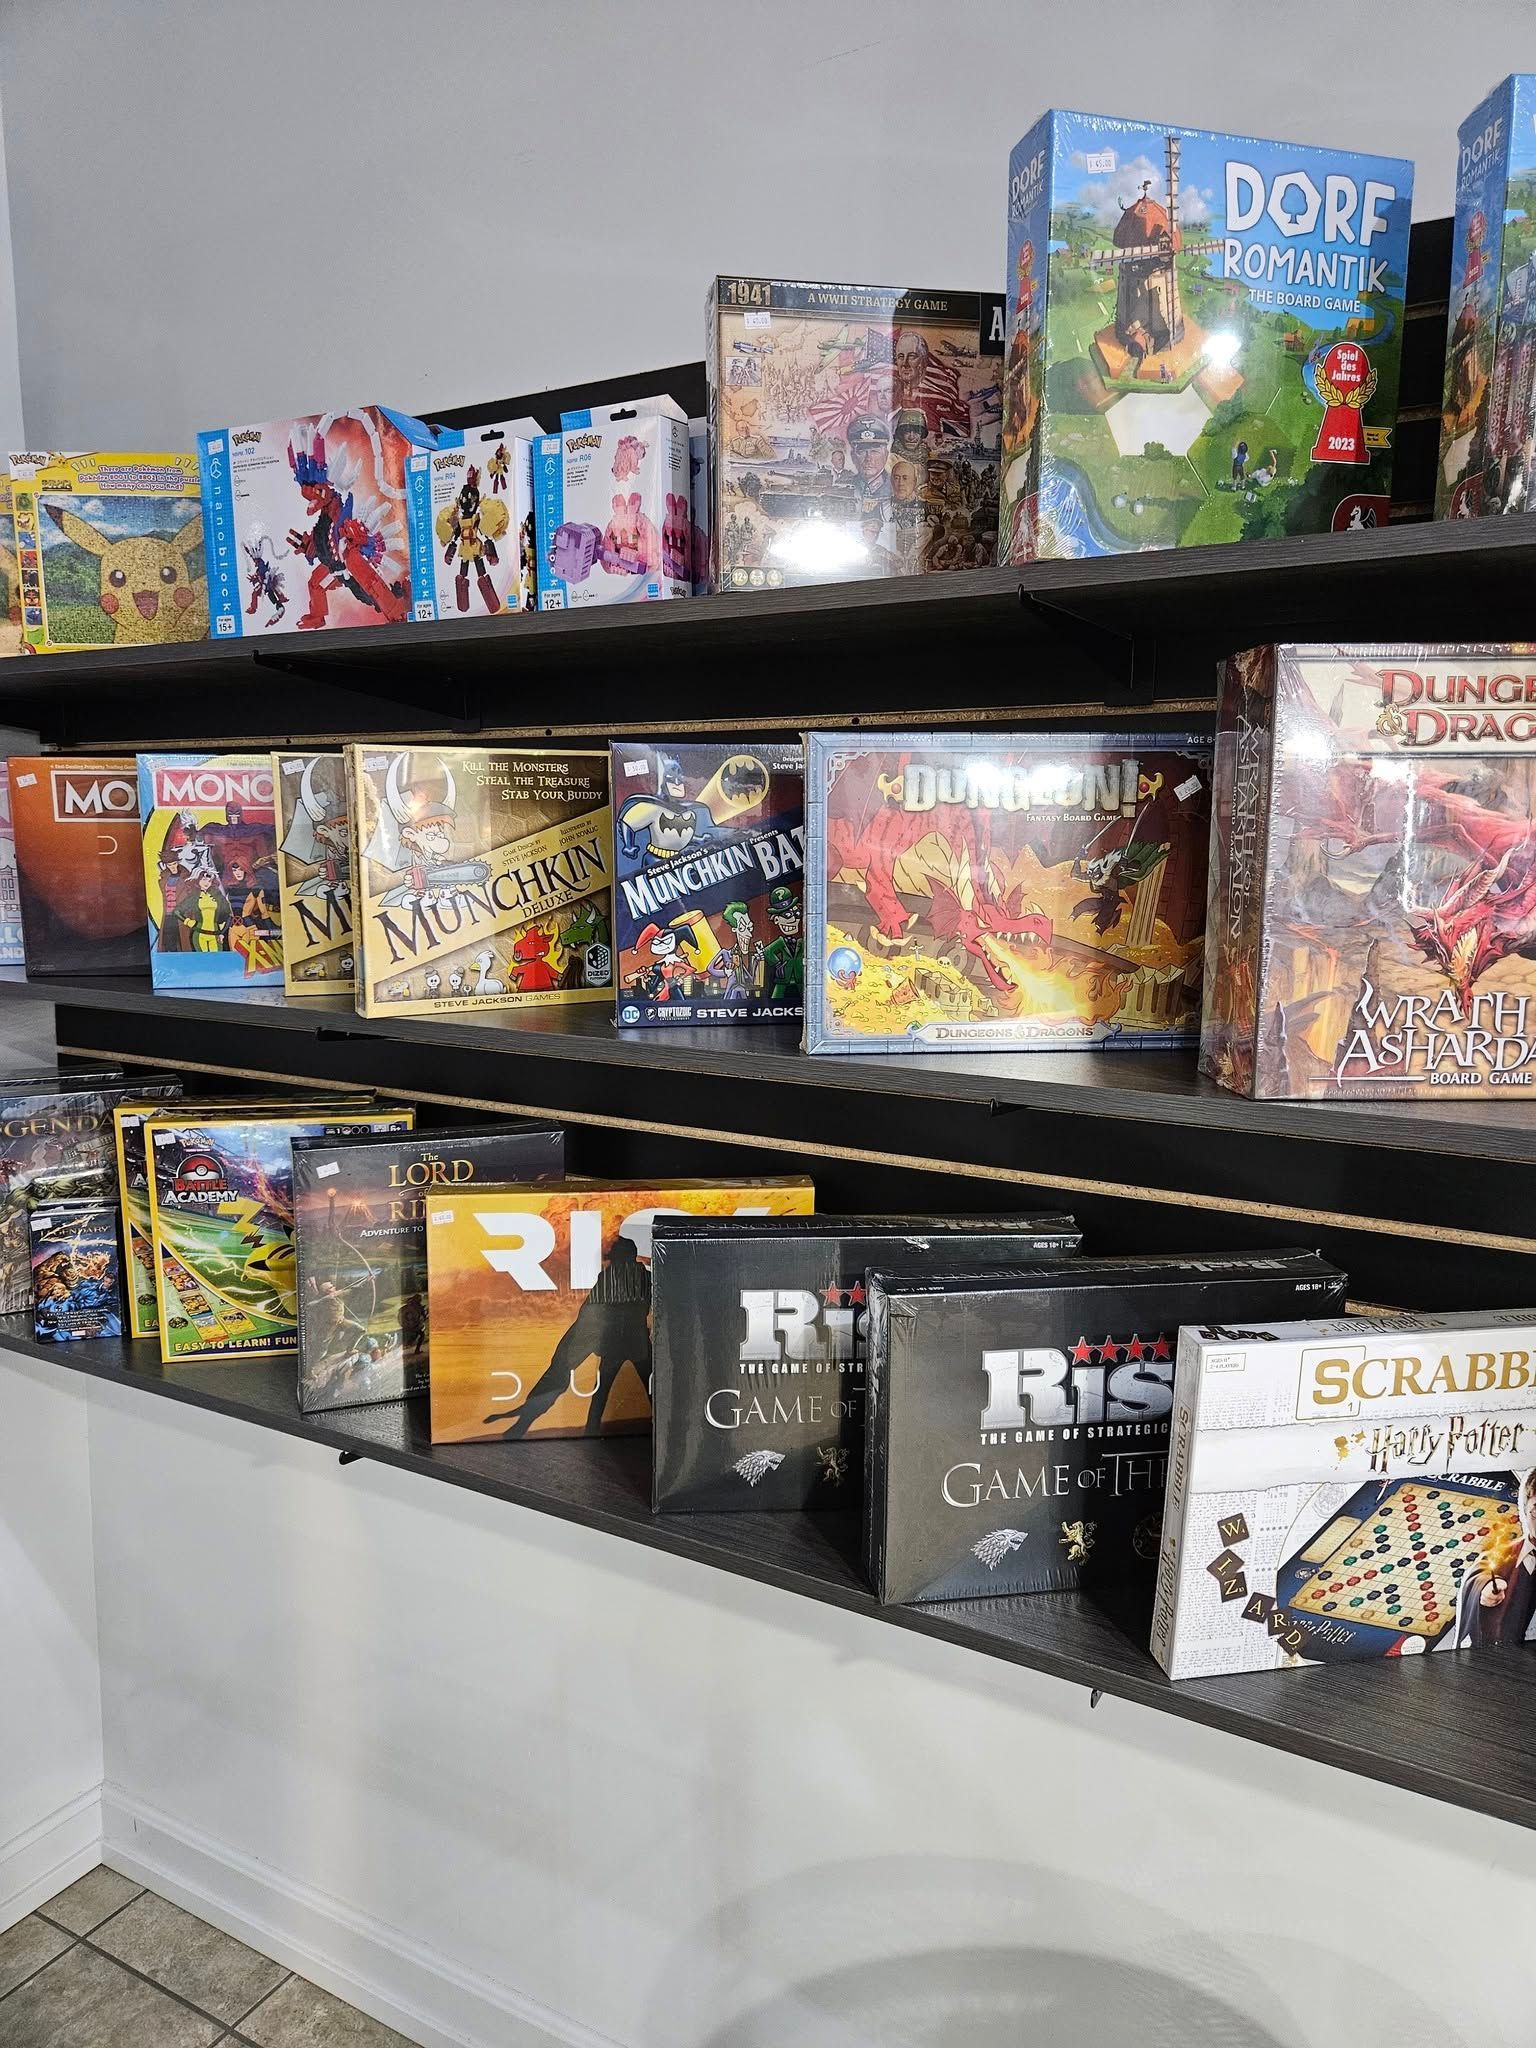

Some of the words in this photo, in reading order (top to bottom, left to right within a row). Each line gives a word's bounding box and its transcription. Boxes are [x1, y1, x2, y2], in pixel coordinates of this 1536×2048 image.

[1462, 117, 1503, 174] DORF
[1012, 149, 1046, 202] DORF
[1225, 160, 1397, 247] DORF
[1224, 238, 1388, 293] ROMANTIK
[727, 282, 771, 306] 1941
[807, 293, 816, 303] A
[818, 293, 848, 305] WWII
[851, 296, 910, 309] STRATEGY
[914, 299, 948, 311] GAME
[1249, 288, 1274, 304] THE
[1277, 292, 1320, 308] BOARD
[1324, 297, 1360, 313] GAME
[1336, 349, 1359, 363] Spiel
[1340, 360, 1356, 372] des
[1332, 370, 1361, 382] Jahres
[244, 447, 255, 455] 102
[1328, 437, 1355, 450] 2023
[133, 465, 164, 473] Pokémon
[165, 466, 183, 474] from
[547, 481, 558, 586] nanoblock
[214, 486, 231, 611] nanoblock
[417, 498, 429, 598] nanoblock
[734, 573, 746, 582] 12+
[544, 599, 562, 609] 12+
[417, 609, 432, 620] 12+
[219, 622, 232, 632] 15+
[1376, 703, 1409, 738] &
[1400, 708, 1536, 748] DRAG
[1187, 736, 1207, 744] AGE
[462, 760, 484, 774] KILL
[488, 761, 509, 771] THE
[513, 762, 569, 774] MONSTERS
[772, 762, 794, 770] Steve
[162, 774, 273, 802] MONO
[476, 775, 511, 786] STEAL
[514, 776, 534, 786] THE
[538, 776, 590, 788] TREASURE
[903, 758, 1139, 818] DUNGEON!
[64, 780, 137, 814] MO
[501, 789, 530, 800] STAB
[533, 790, 567, 801] YOUR
[567, 791, 603, 801] BUDDY
[1026, 813, 1062, 822] FANTASY
[1063, 813, 1092, 822] BOARD
[1094, 814, 1118, 822] GAME
[559, 836, 576, 847] JOHN
[749, 829, 779, 844] Presents
[503, 856, 520, 866] STEVE
[521, 845, 548, 861] JACKSON
[647, 861, 671, 877] Steve
[670, 848, 709, 870] Jackson's
[621, 841, 754, 921] MUNCHKIN
[373, 836, 607, 965] MUNCHKIN
[522, 889, 573, 918] DELUXE
[587, 969, 609, 977] DIZED
[434, 1000, 468, 1009] STEVE
[472, 996, 522, 1006] JACKSON
[526, 993, 561, 1002] GAMES
[1355, 977, 1530, 1038] WRATH
[624, 1009, 640, 1020] DC
[657, 1006, 692, 1017] CRYPTOZOIC
[697, 1009, 747, 1018] STEVE
[752, 1007, 804, 1017] JACKS
[935, 1027, 1013, 1039] DUNGEONS
[1025, 1026, 1095, 1038] DRAGONS
[1430, 1073, 1482, 1084] BOARD
[1489, 1073, 1532, 1084] GAME
[0, 1116, 114, 1138] GENDA
[420, 1152, 439, 1162] The
[388, 1159, 475, 1188] LORD
[174, 1178, 228, 1191] BATTLE
[161, 1190, 239, 1206] ACADEMY
[360, 1225, 409, 1238] ADVENTURE
[174, 1341, 206, 1352] EASY
[211, 1341, 225, 1350] TO
[228, 1338, 271, 1349] LEARN!
[275, 1335, 297, 1345] FUN
[740, 1363, 764, 1375] THE
[771, 1363, 808, 1375] GAME
[816, 1363, 831, 1374] OF
[838, 1362, 863, 1374] STR
[704, 1389, 823, 1429] GAME
[830, 1400, 857, 1418] OF
[980, 1433, 1007, 1445] THE
[1015, 1430, 1055, 1443] GAME
[1062, 1428, 1081, 1440] OF
[1087, 1422, 1169, 1438] STRATEGIC
[1366, 1423, 1444, 1475] Harry
[1445, 1415, 1525, 1473] Potter
[1171, 1406, 1190, 1510] SCRABBLE
[941, 1462, 1070, 1508] GAME
[1077, 1468, 1106, 1489] OF
[1317, 1618, 1358, 1646] Potter
